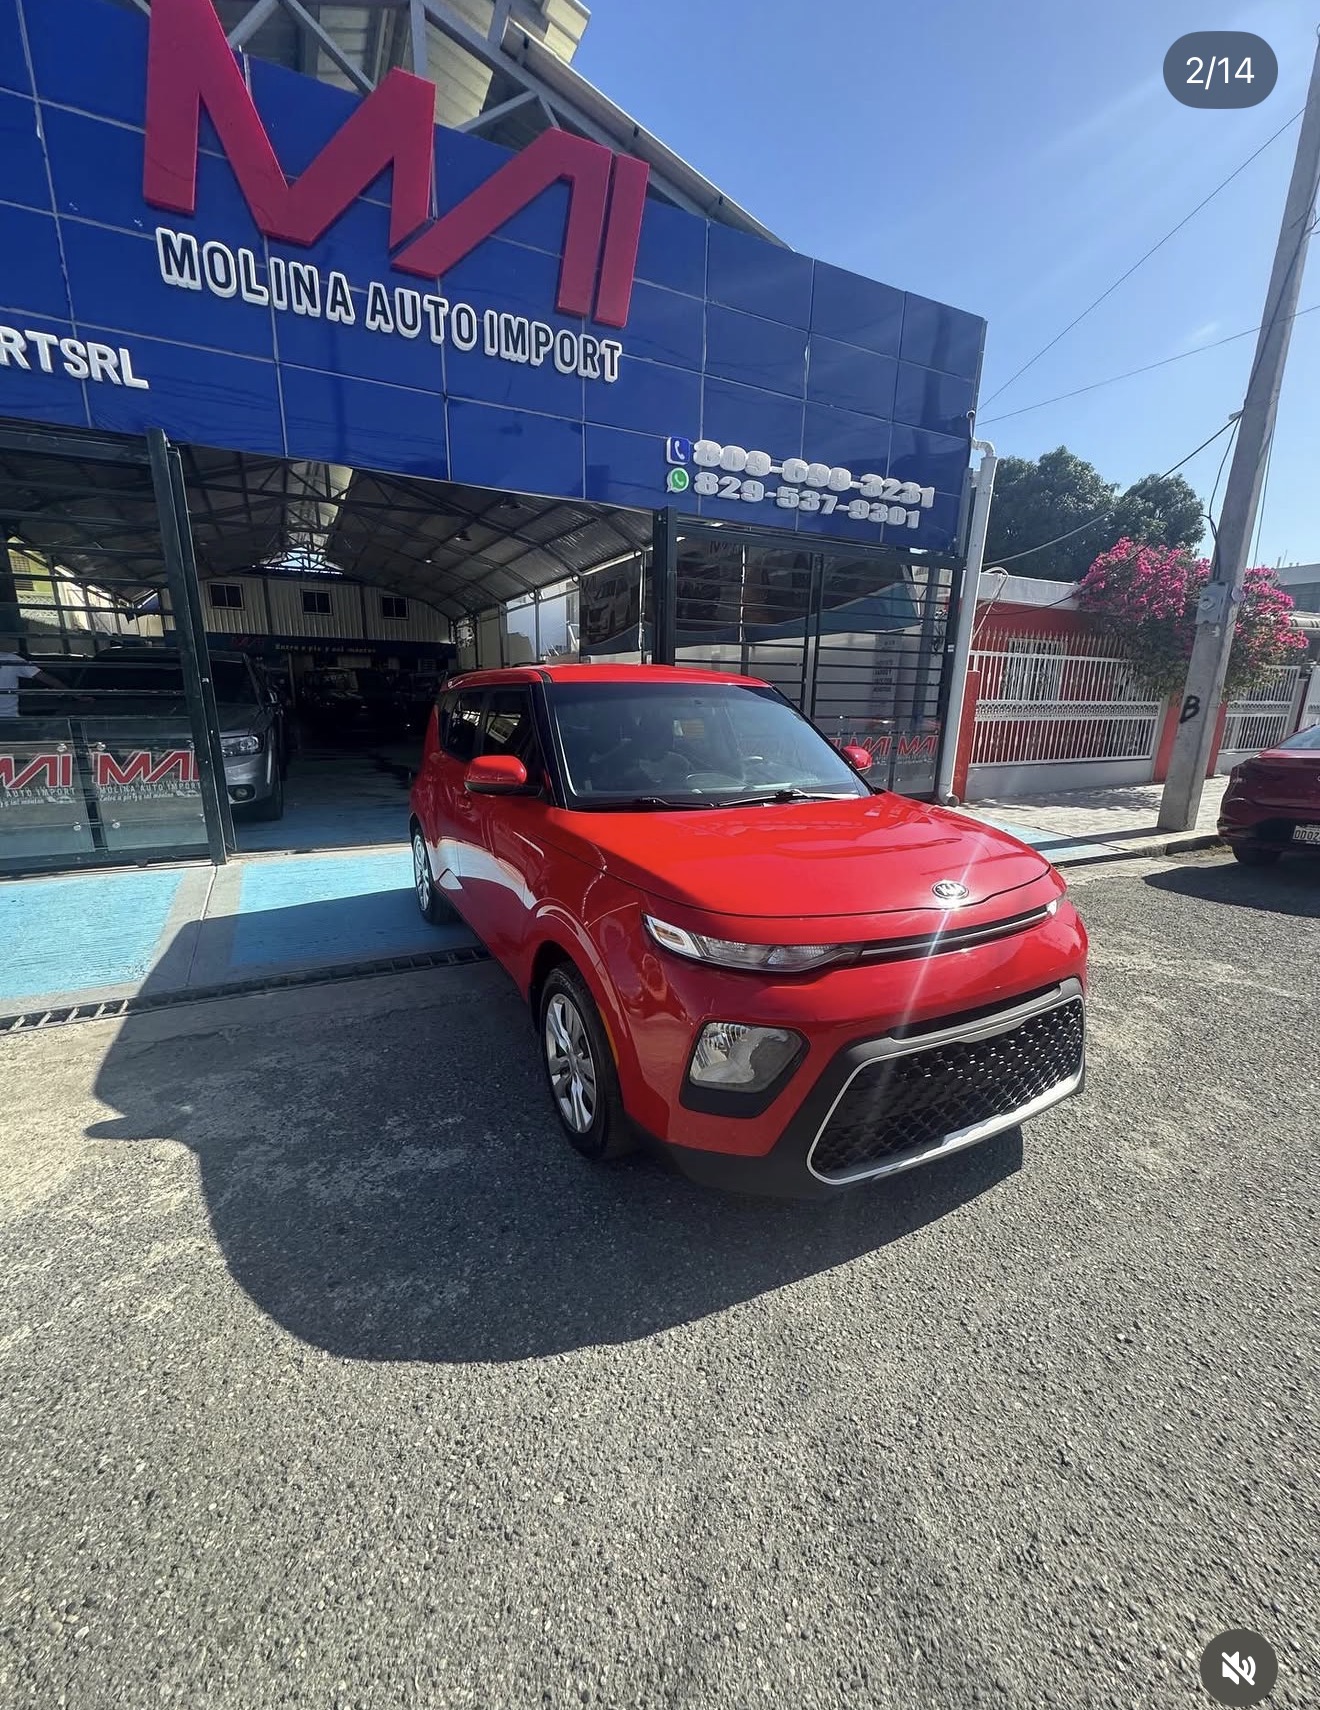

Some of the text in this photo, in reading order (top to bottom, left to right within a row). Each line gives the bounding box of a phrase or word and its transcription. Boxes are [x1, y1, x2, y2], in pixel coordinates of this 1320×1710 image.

[156, 226, 622, 383] MOLINA AUTO IMPORT
[693, 471, 921, 529] 829-537-9301
[1180, 695, 1200, 724] B
[6, 787, 76, 799] AUTO IMPORT
[140, 783, 164, 793] AUTO
